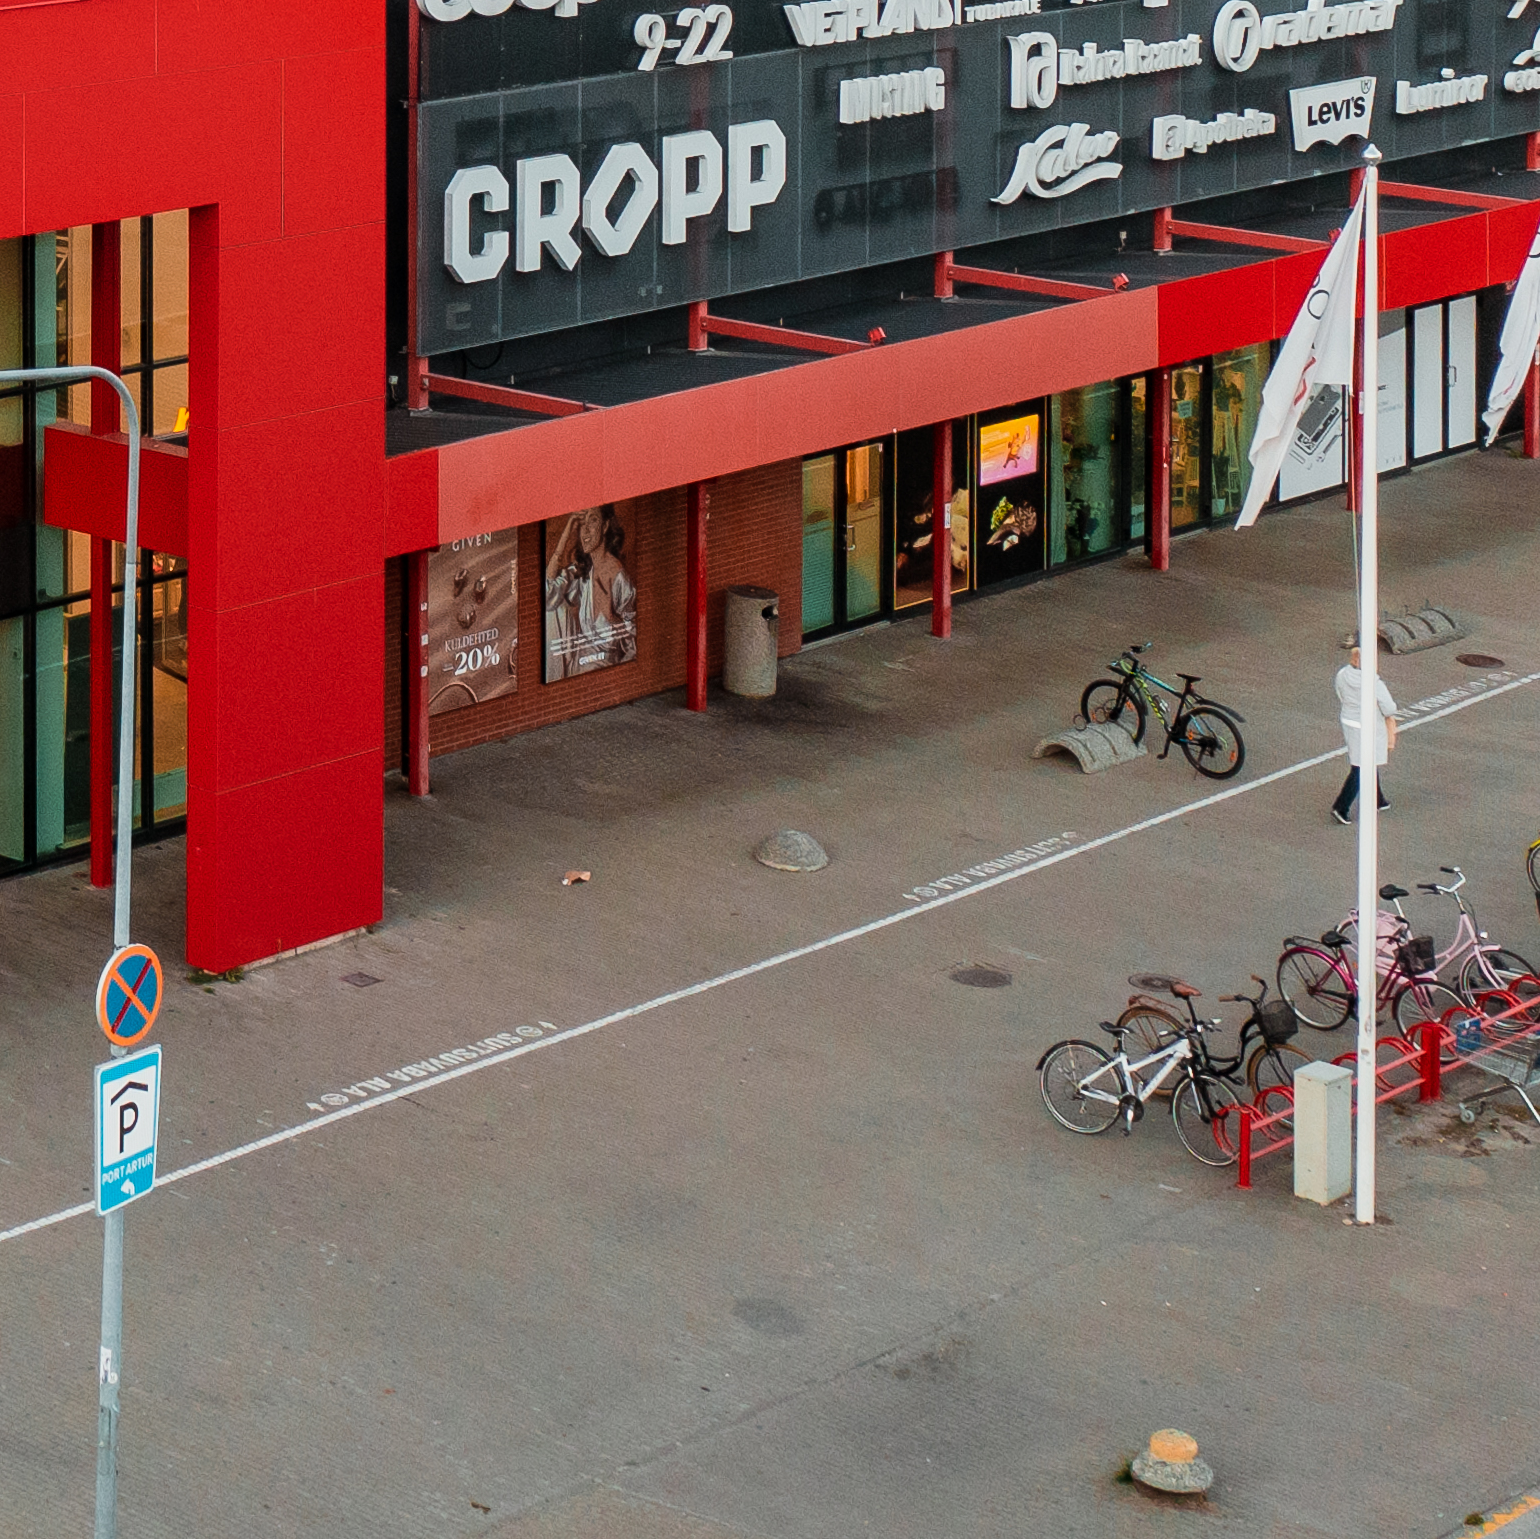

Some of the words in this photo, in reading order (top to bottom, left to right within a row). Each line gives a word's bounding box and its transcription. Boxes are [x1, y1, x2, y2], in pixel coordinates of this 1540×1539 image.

[633, 4, 734, 71] 9-22
[1396, 67, 1489, 115] Luminor
[443, 118, 787, 284] CROPP
[341, 1076, 392, 1098] ALA
[119, 1102, 139, 1154] P
[102, 1165, 125, 1186] PORT
[125, 1152, 154, 1175] ARTUR
